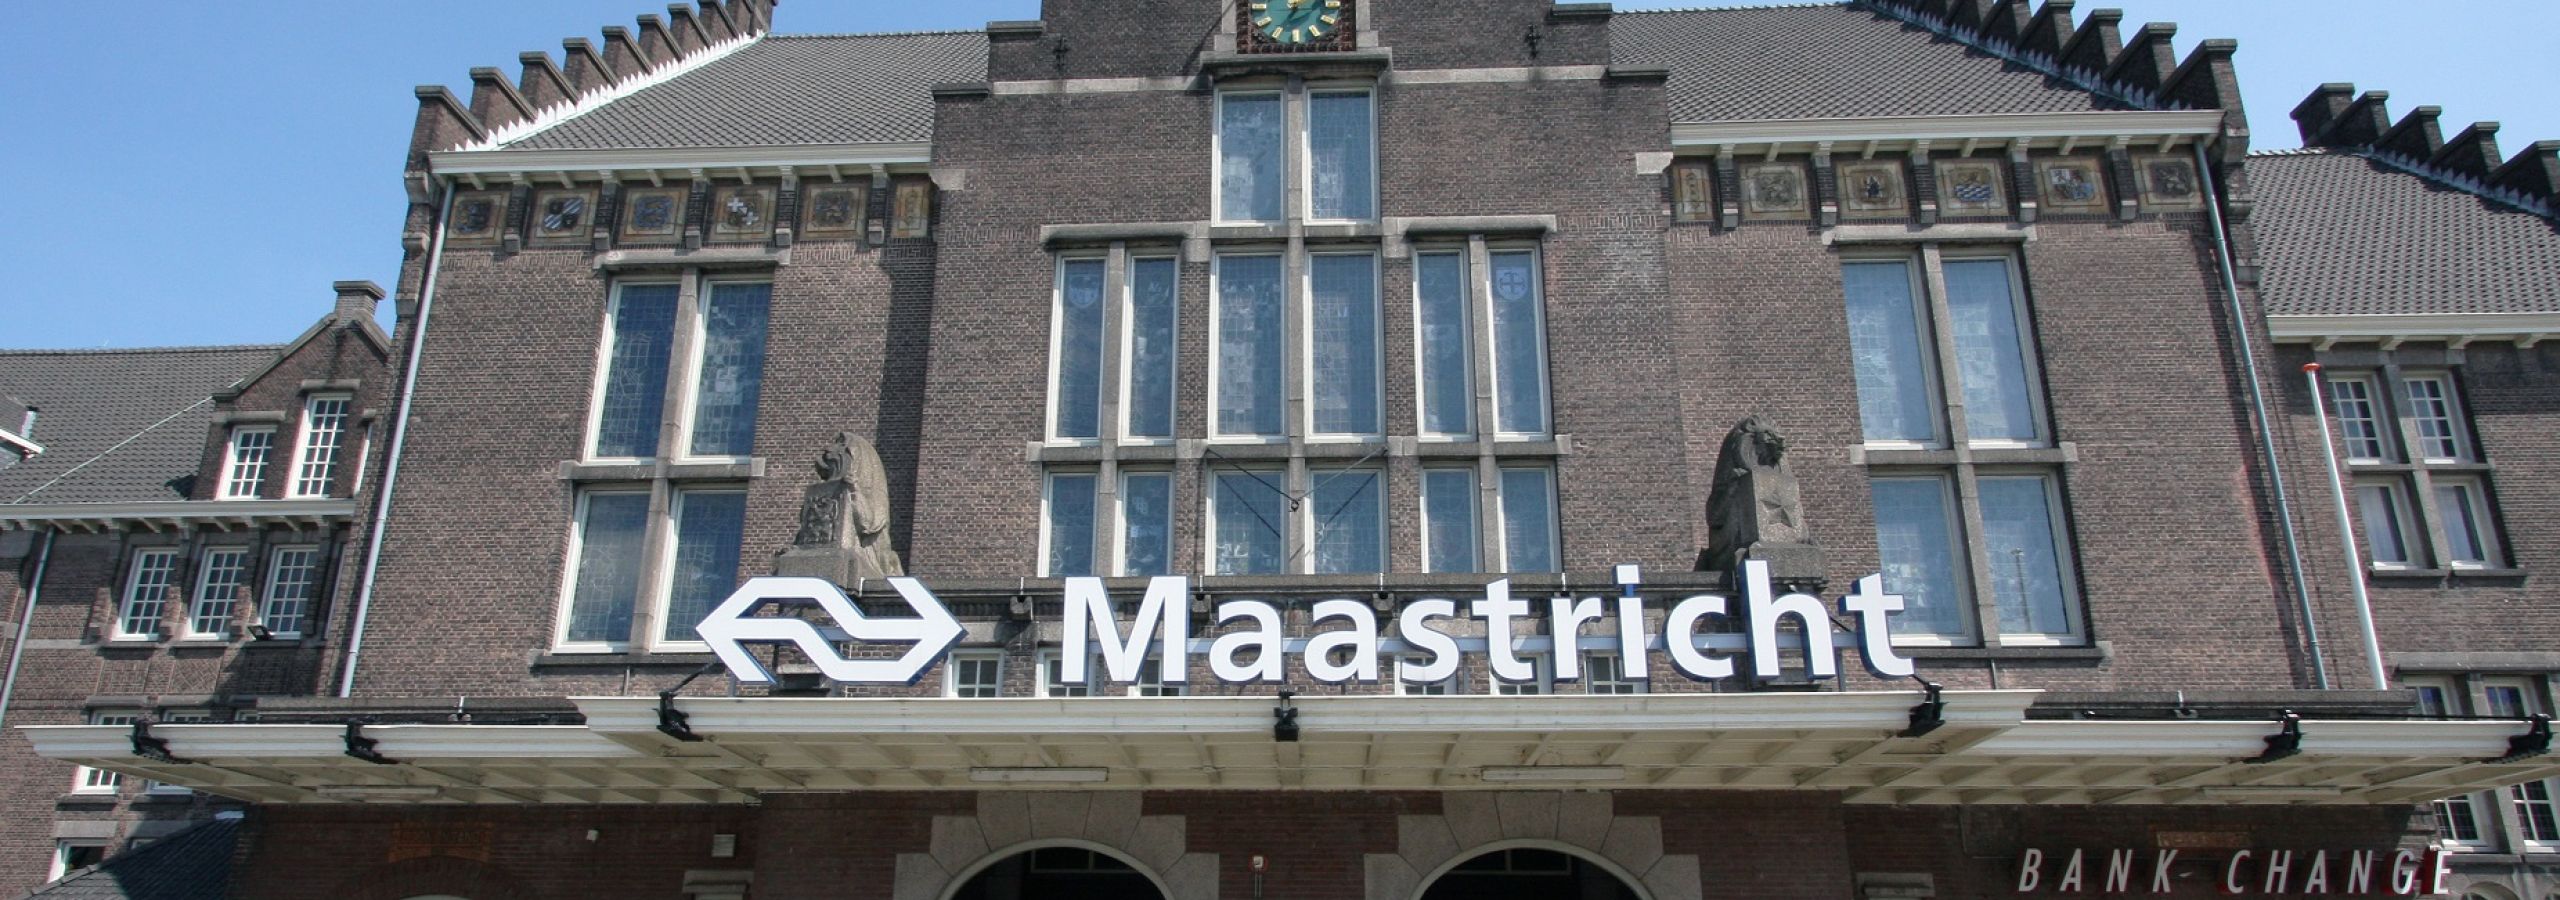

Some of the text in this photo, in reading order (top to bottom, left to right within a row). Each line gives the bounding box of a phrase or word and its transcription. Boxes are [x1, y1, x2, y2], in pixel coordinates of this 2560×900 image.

[1061, 560, 1916, 684] Maastricht
[2018, 848, 2454, 895] BANK CHANGE
